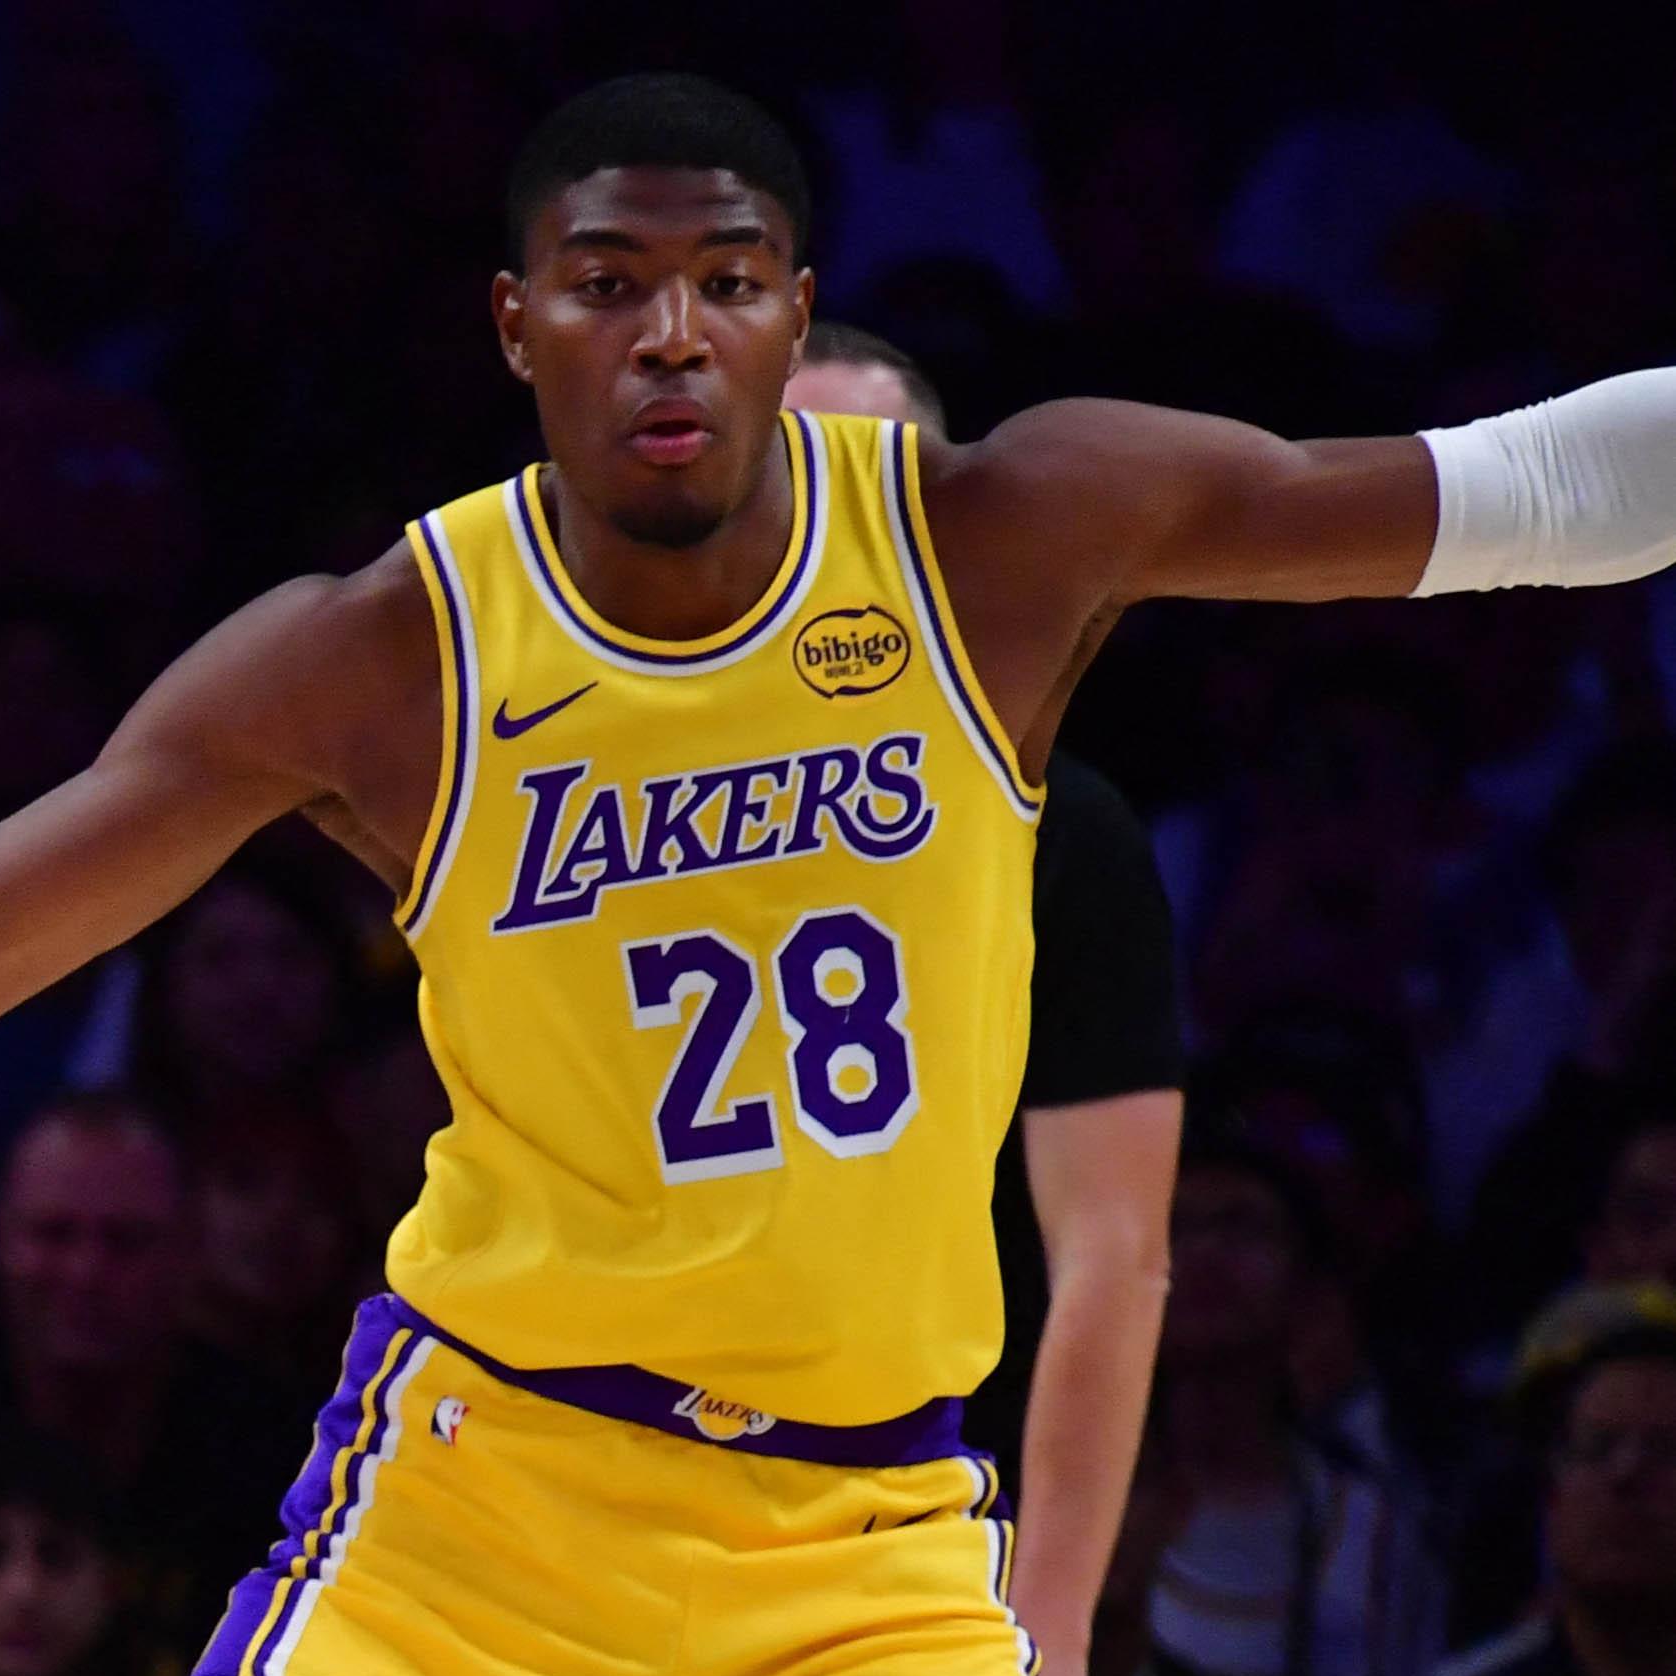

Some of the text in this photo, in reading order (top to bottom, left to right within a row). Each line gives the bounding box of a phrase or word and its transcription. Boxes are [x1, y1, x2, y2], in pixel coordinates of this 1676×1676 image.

[803, 631, 902, 667] bibigo
[489, 731, 939, 936] LAKERS
[621, 904, 919, 1186] 28
